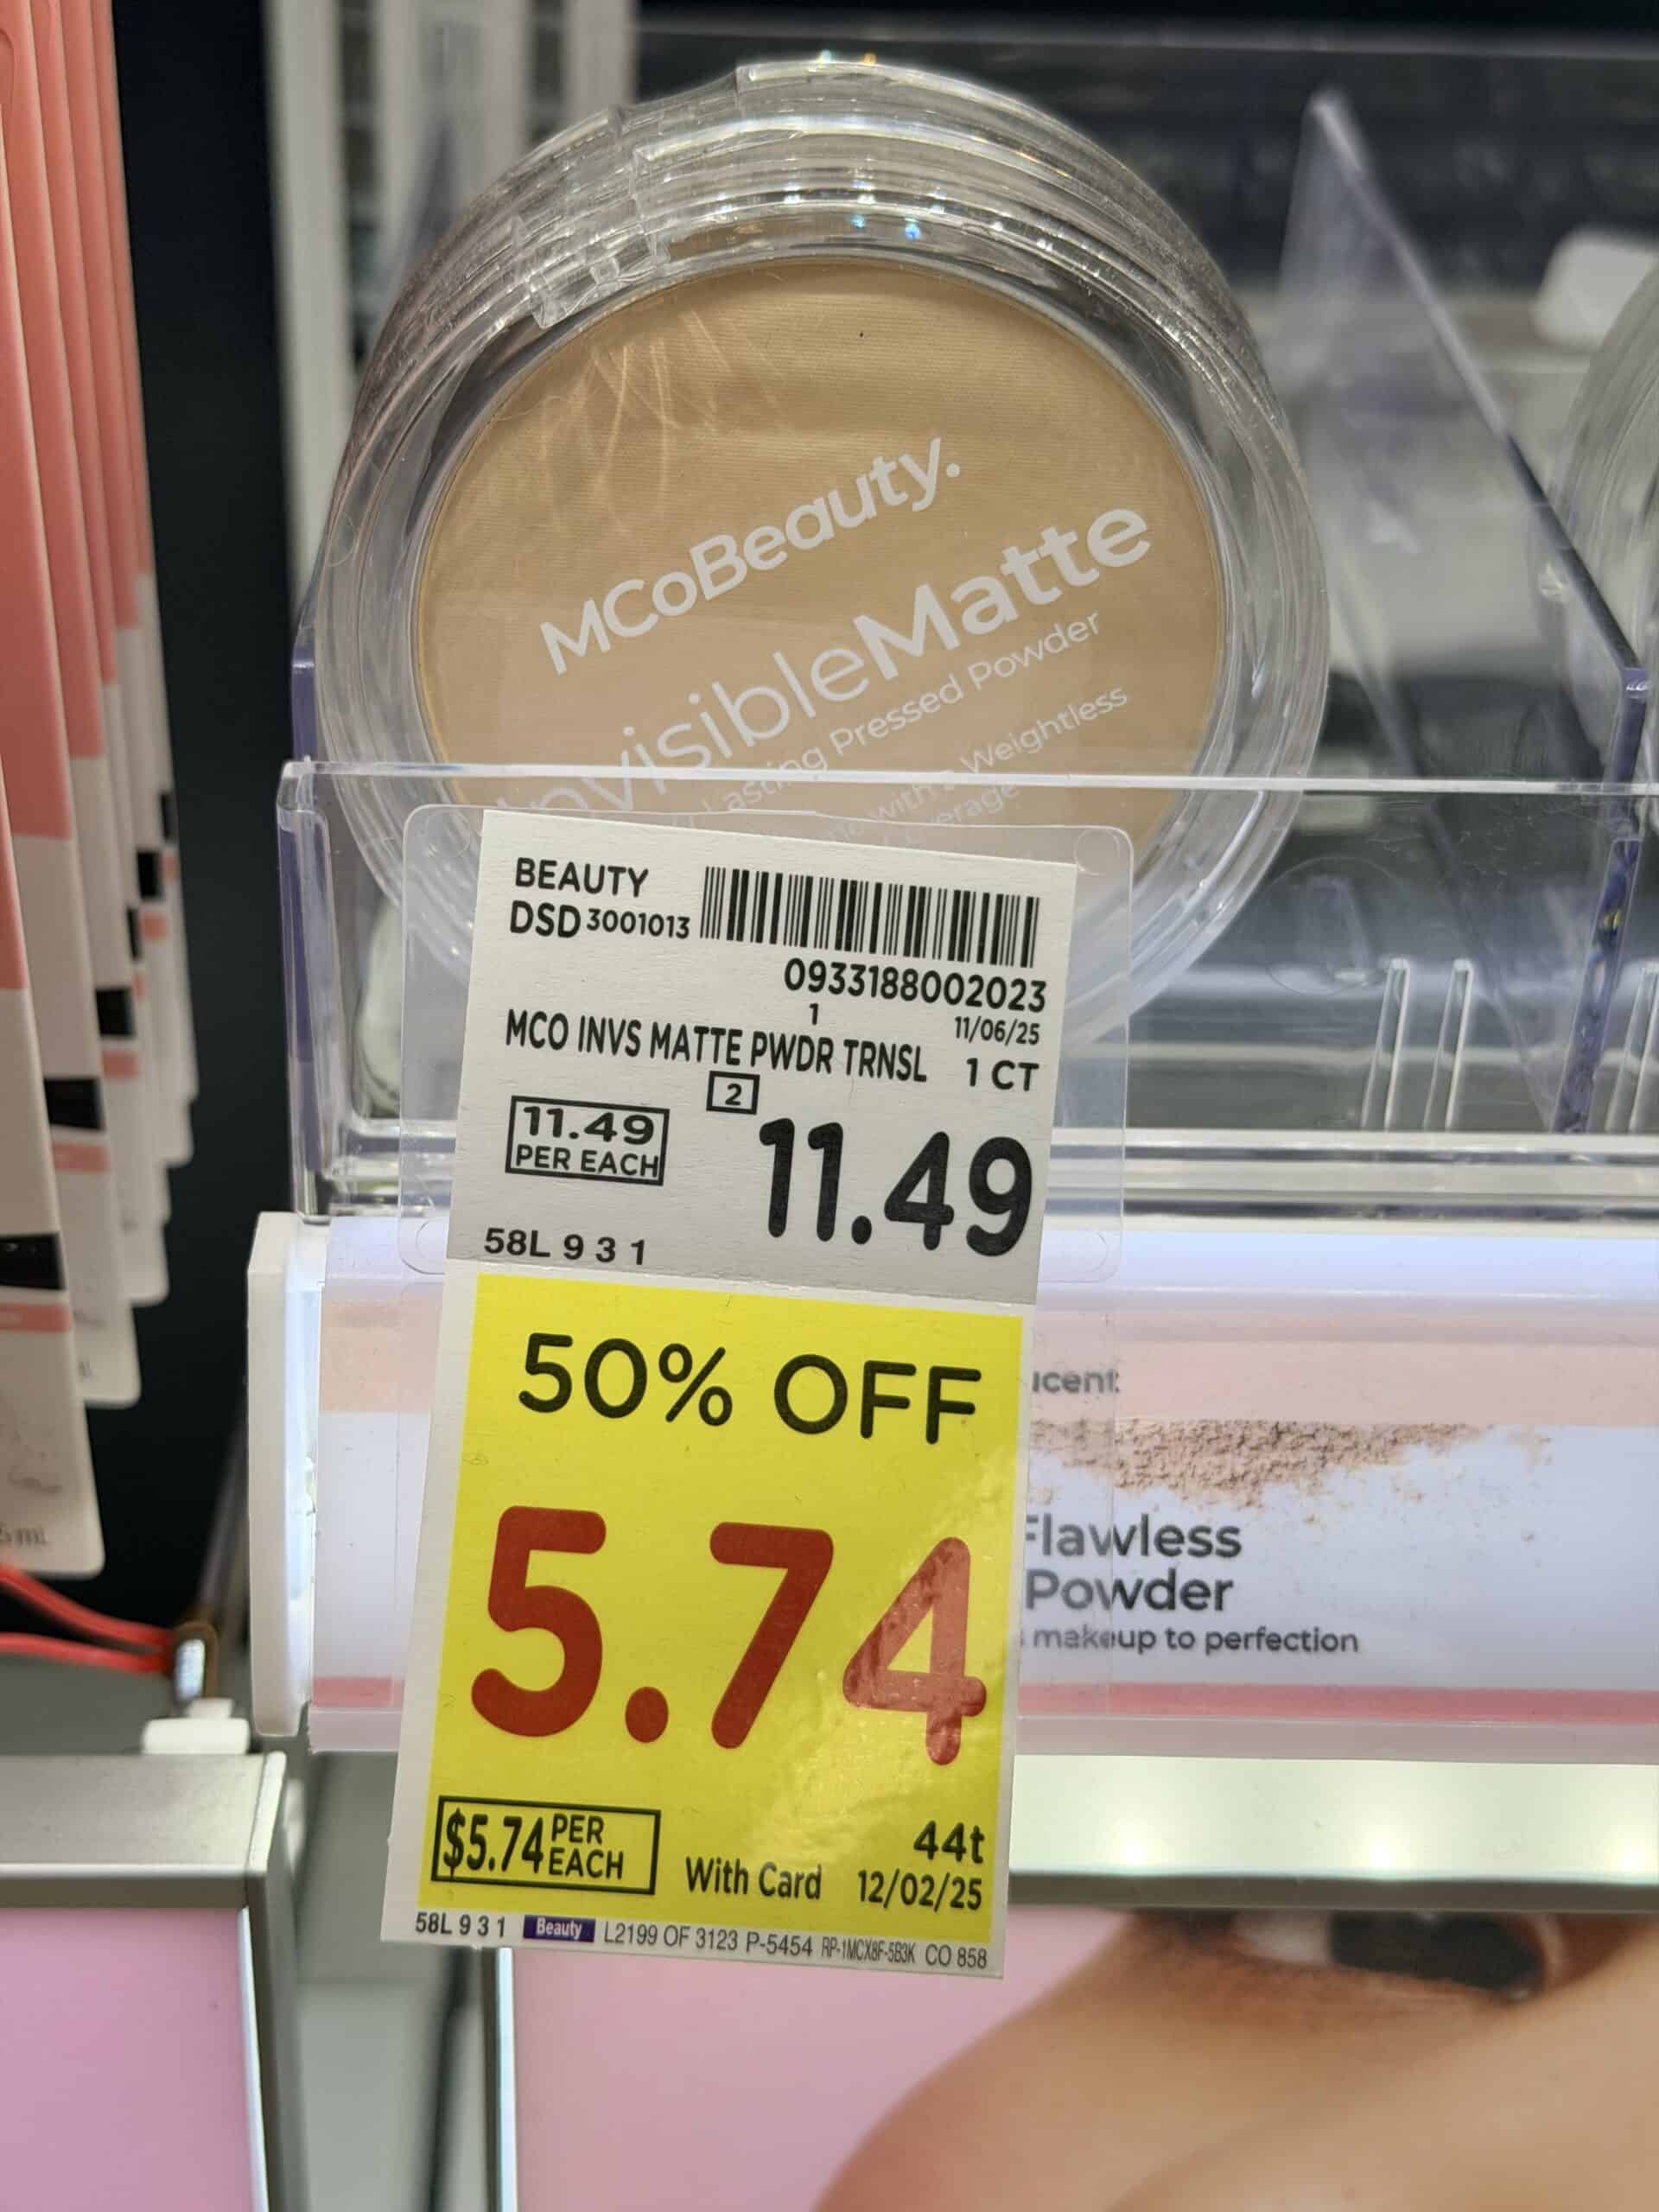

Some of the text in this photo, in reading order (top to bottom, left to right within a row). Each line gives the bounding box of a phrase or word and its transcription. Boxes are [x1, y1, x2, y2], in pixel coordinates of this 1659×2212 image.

[540, 437, 960, 675] MCoBeauty.
[830, 675, 963, 754] Pressed
[967, 610, 1102, 691] Powder
[959, 687, 1128, 774] Weightless
[515, 857, 649, 898] BEAUTY
[509, 899, 690, 939] DSD 3001013
[784, 957, 1046, 1012] 0933188002023
[809, 1003, 1040, 1046] 1 11/06/25
[505, 1008, 1039, 1091] MCO INVS MATTE PWDR TRNSL 1 CT
[724, 1083, 742, 1106] 2
[522, 1106, 656, 1145] 11.49
[515, 1144, 659, 1179] PER EACH
[759, 1117, 1033, 1257] 11.49
[483, 1227, 646, 1266] 58L 9 3 1
[518, 1332, 982, 1446] 50% OFF
[1026, 1567, 1234, 1611] Powder
[471, 1504, 988, 1766] 5.74
[1033, 1624, 1155, 1655] makeup
[1166, 1628, 1196, 1650] to
[1205, 1627, 1359, 1656] perfection
[442, 1808, 544, 1877] $5.74
[550, 1814, 604, 1846] PER
[913, 1820, 985, 1865] 44t
[549, 1847, 624, 1880] EACH
[686, 1856, 823, 1900] With Card
[857, 1869, 983, 1910] 12/02/25
[415, 1911, 453, 1936] 58L
[459, 1914, 471, 1936] 9
[477, 1916, 490, 1937] 3
[497, 1916, 506, 1937] 1
[537, 1917, 583, 1941] Beauty
[604, 1920, 658, 1946] L2199
[663, 1924, 690, 1947] OF
[696, 1927, 738, 1951] 3123
[746, 1932, 813, 1957] P-5454
[925, 1943, 951, 1967] CO
[957, 1947, 987, 1969] 858
